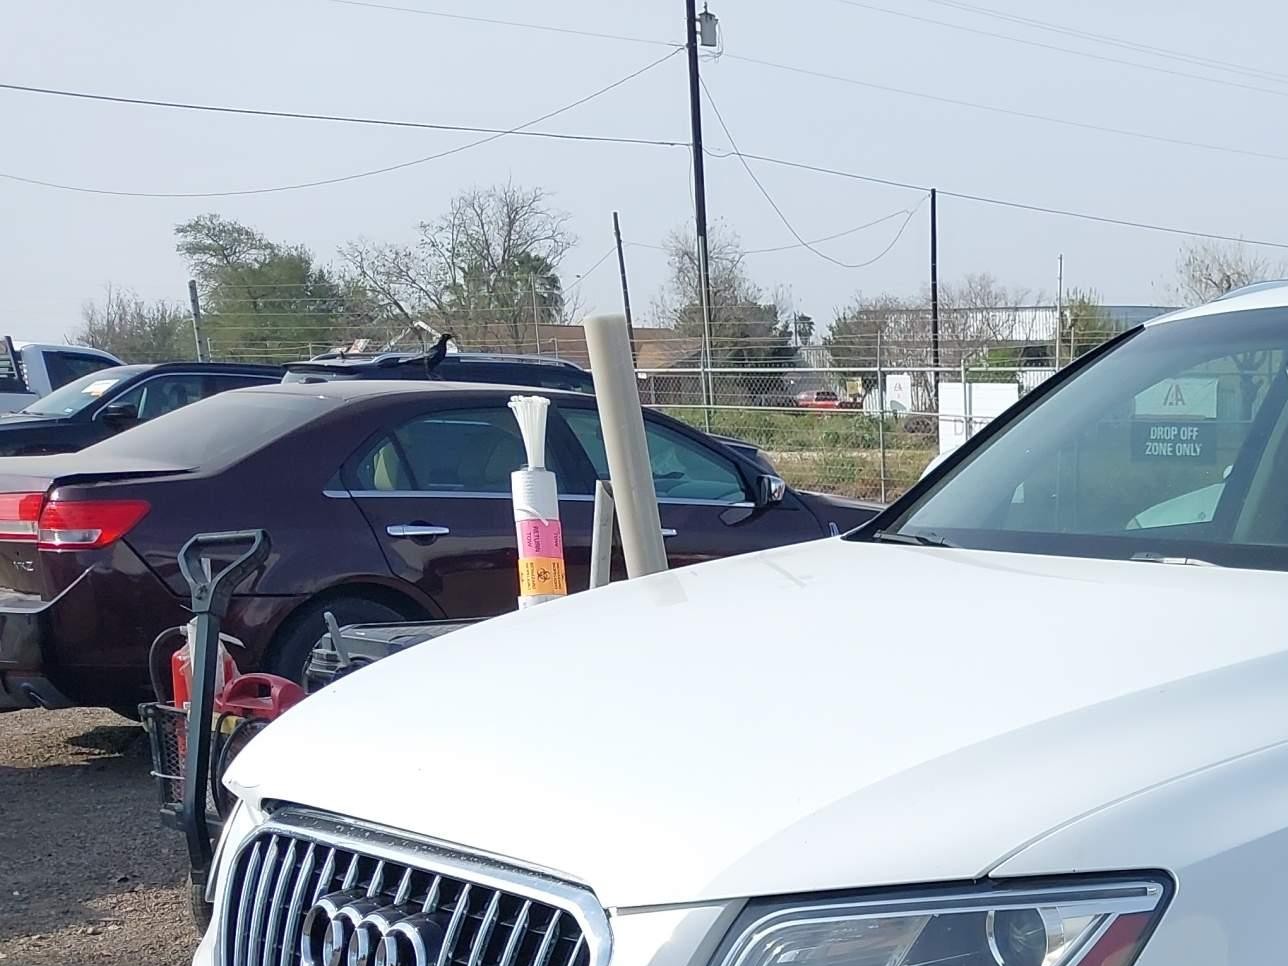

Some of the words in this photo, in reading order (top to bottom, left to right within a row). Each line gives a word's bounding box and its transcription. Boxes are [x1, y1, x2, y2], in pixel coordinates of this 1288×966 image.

[1150, 426, 1178, 440] DROP
[1180, 427, 1199, 440] OFF
[1145, 442, 1173, 455] ZONE
[1175, 443, 1202, 456] ONLY
[533, 526, 541, 552] RETURN
